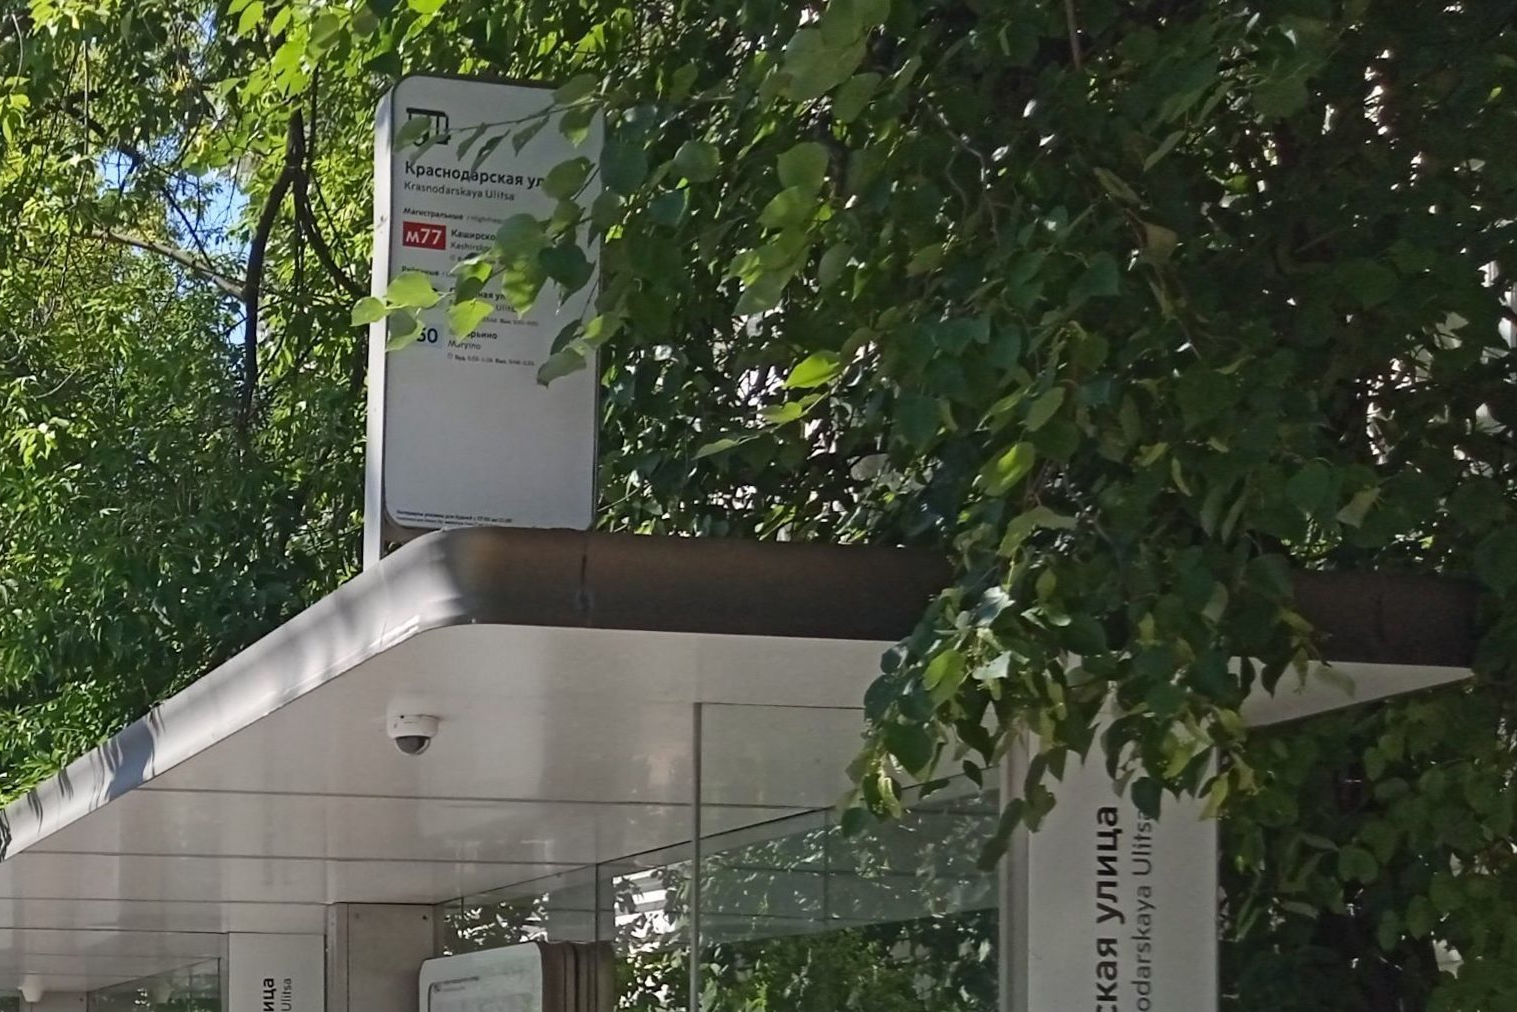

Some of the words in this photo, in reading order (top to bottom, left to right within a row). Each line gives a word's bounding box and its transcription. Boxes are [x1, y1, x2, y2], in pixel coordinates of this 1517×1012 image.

[405, 161, 523, 187] Краснодарская
[527, 176, 545, 190] ул
[404, 182, 483, 199] Krasnodarskaya
[485, 190, 515, 201] Ulitsa
[451, 229, 497, 241] Каширско
[417, 328, 438, 343] 50
[1095, 806, 1126, 925] улица
[281, 978, 292, 1012] Ulitsa
